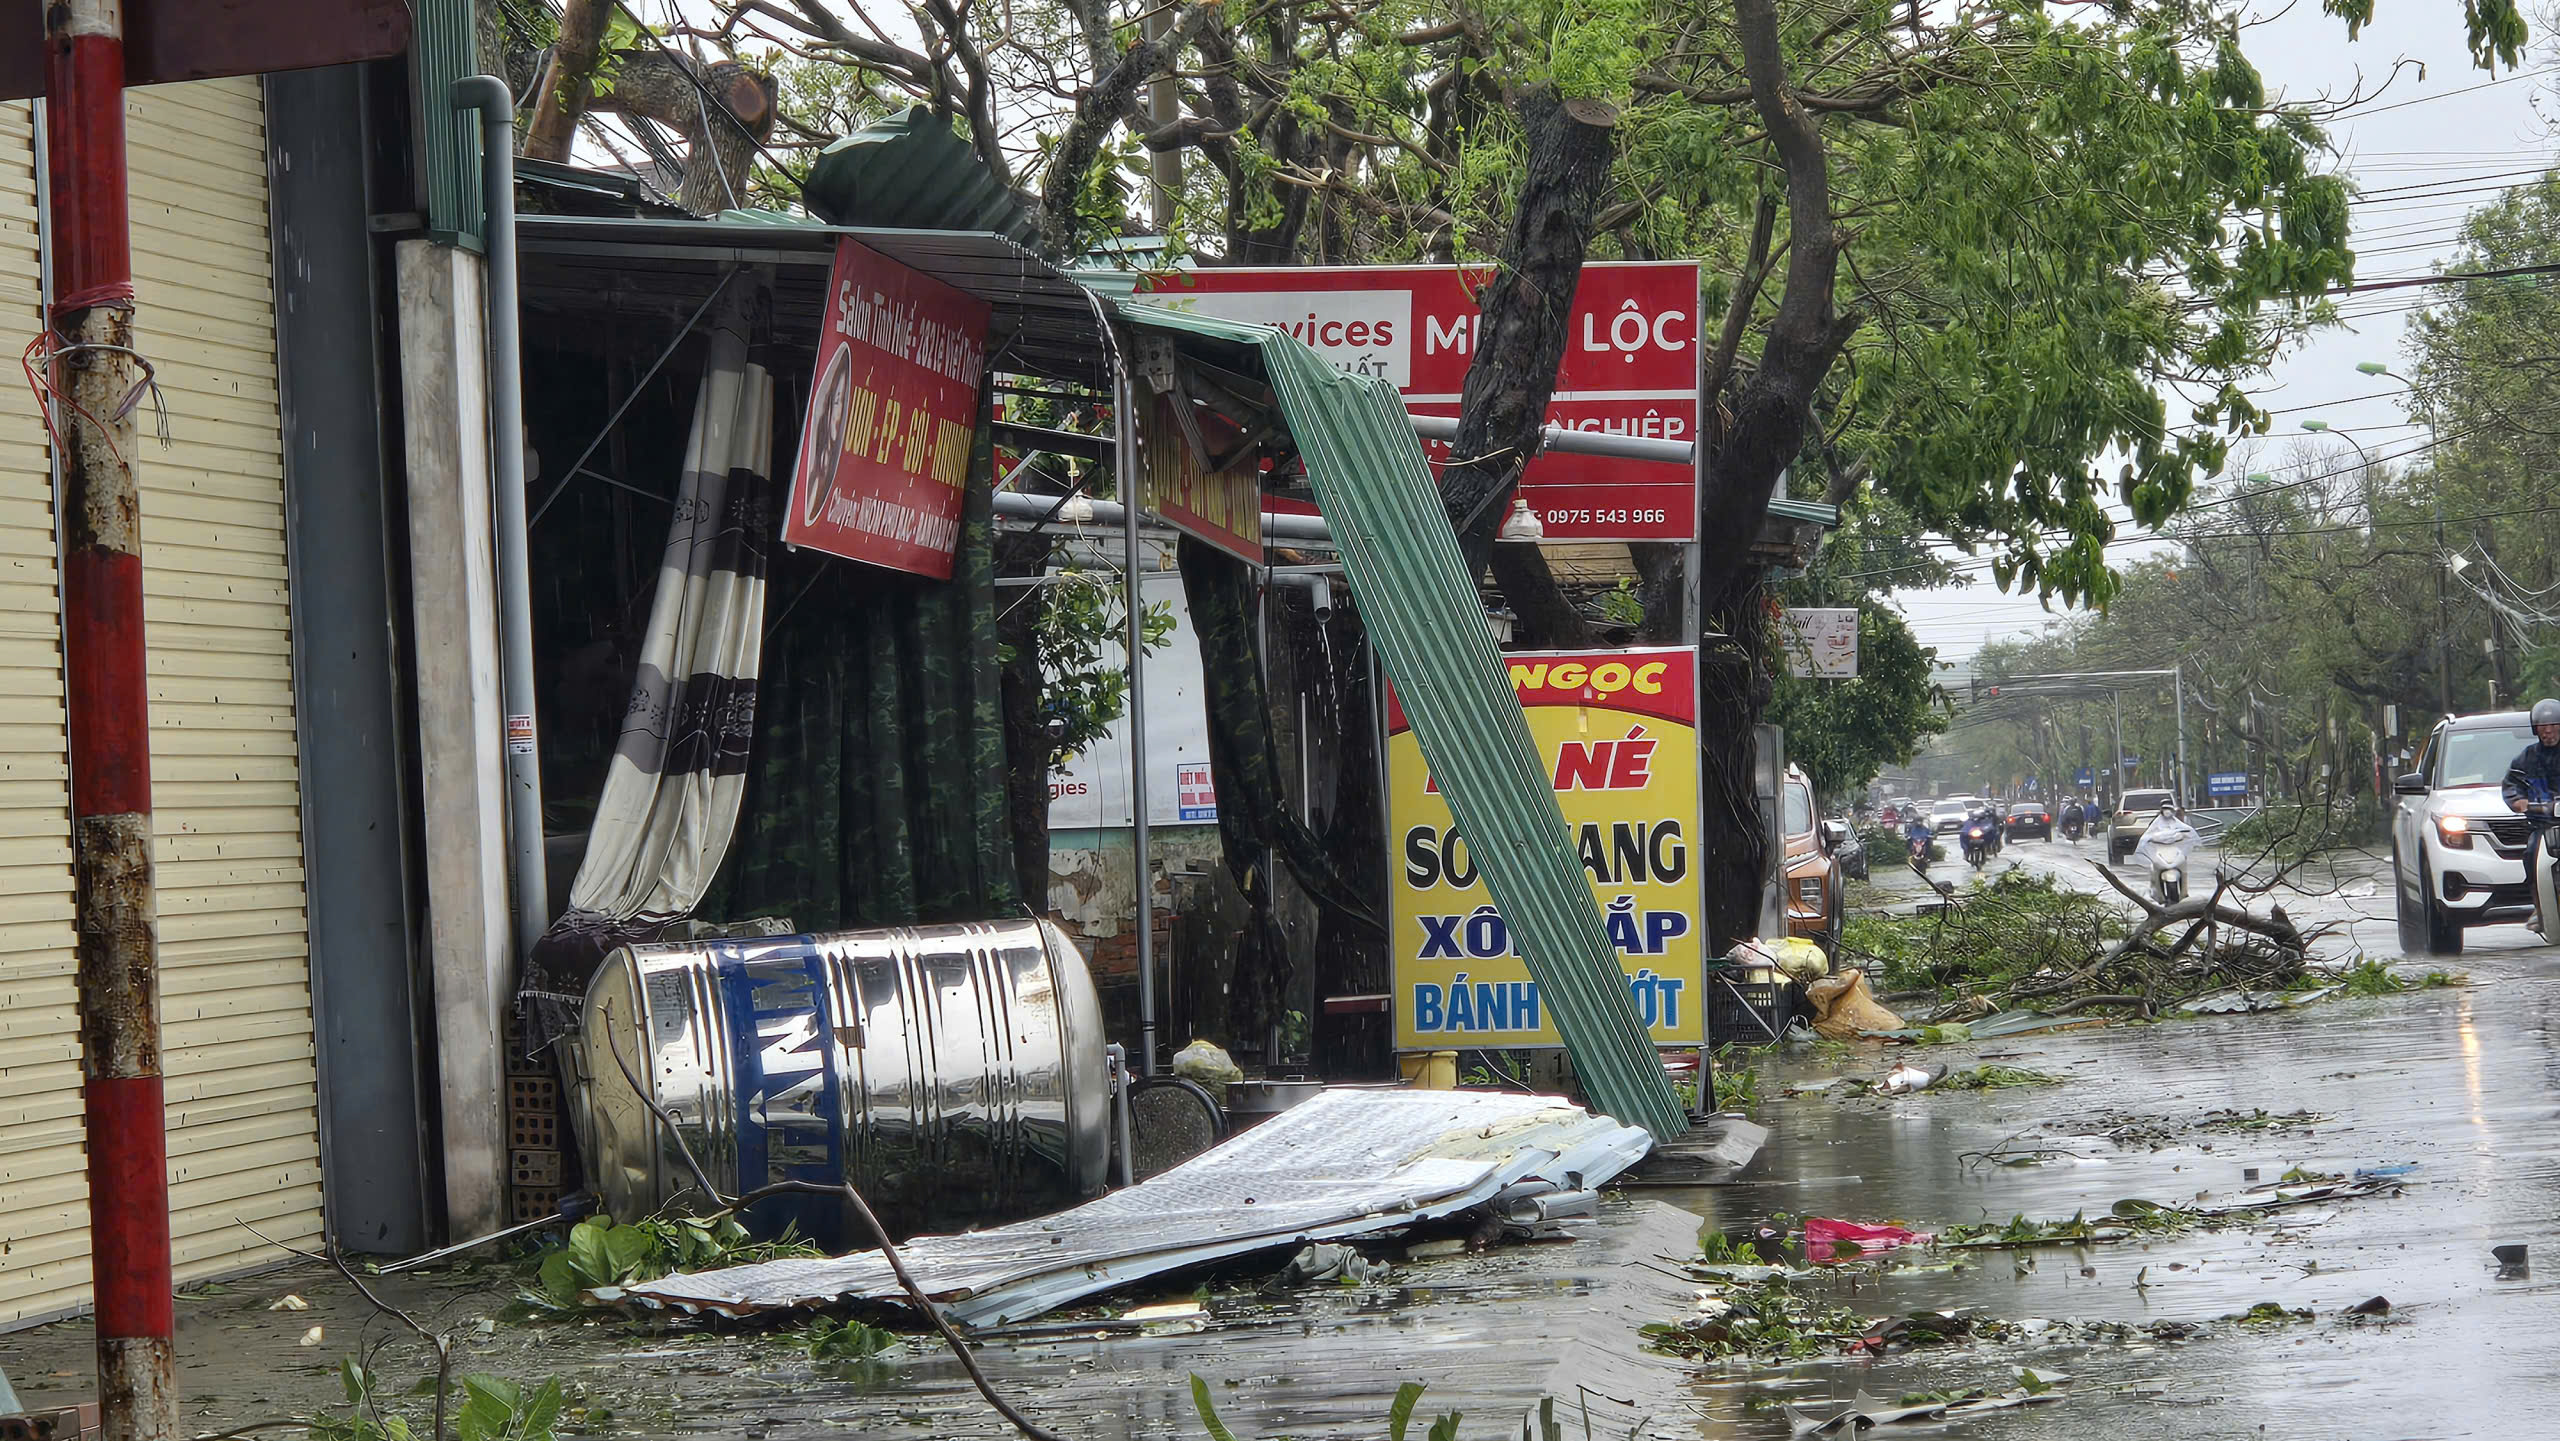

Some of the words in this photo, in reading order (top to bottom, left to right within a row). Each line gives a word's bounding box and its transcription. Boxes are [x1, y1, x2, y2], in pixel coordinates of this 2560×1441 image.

[836, 280, 871, 343] Salon
[1264, 313, 1393, 347] vices
[1584, 299, 1686, 363] LỘC
[1547, 510, 1590, 523] 0975
[1596, 510, 1627, 523] 543
[1632, 510, 1665, 523] 966
[1508, 663, 1668, 701] NGỌC
[1552, 724, 1657, 791] NÉ
[1567, 820, 1686, 884] ANG
[1418, 906, 1521, 959] XÔ
[1607, 895, 1687, 954] ẮP
[1415, 973, 1540, 1032] BÁNH
[1626, 969, 1683, 1028] ỚT
